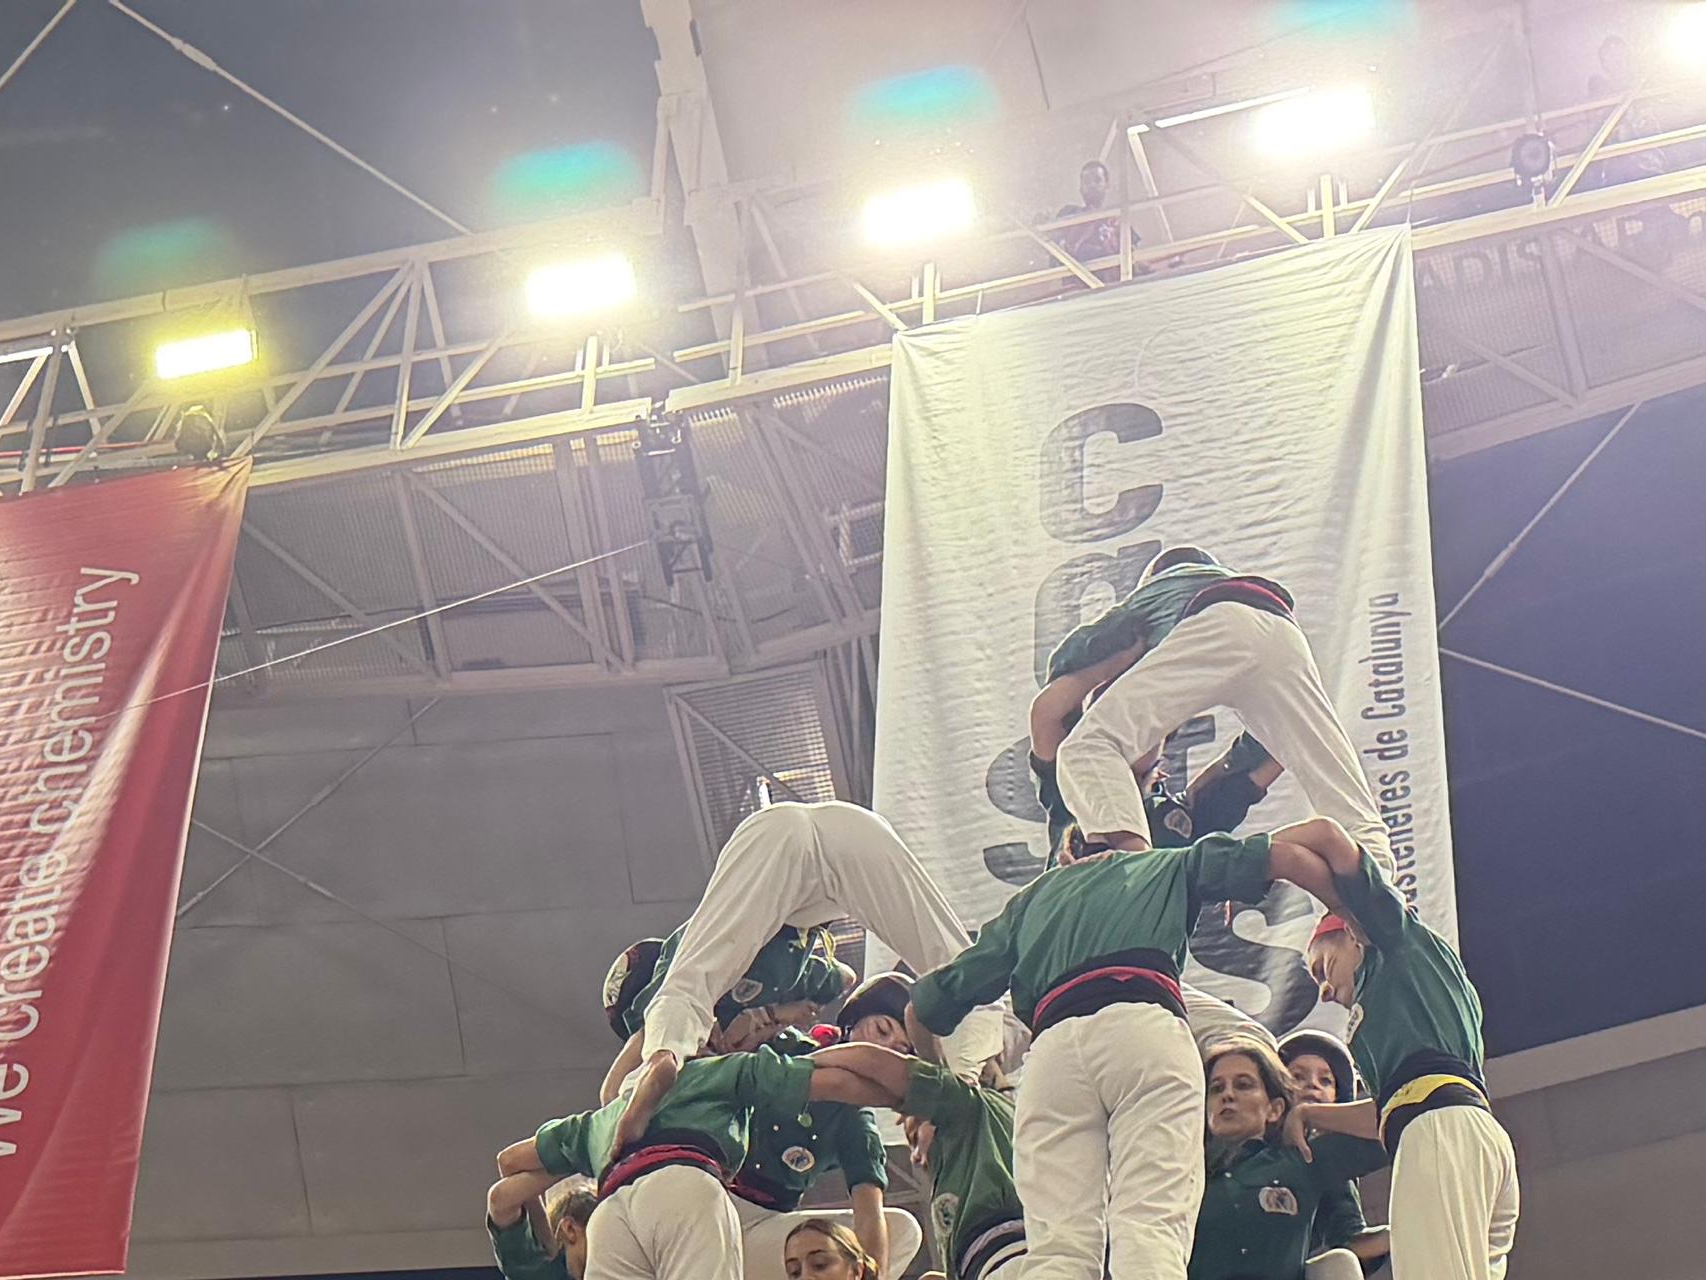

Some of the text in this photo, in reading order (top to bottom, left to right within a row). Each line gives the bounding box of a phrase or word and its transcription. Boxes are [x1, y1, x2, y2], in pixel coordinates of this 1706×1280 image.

[19, 567, 141, 835] chemistry
[1357, 592, 1412, 720] Catalunya
[1362, 729, 1409, 762] de
